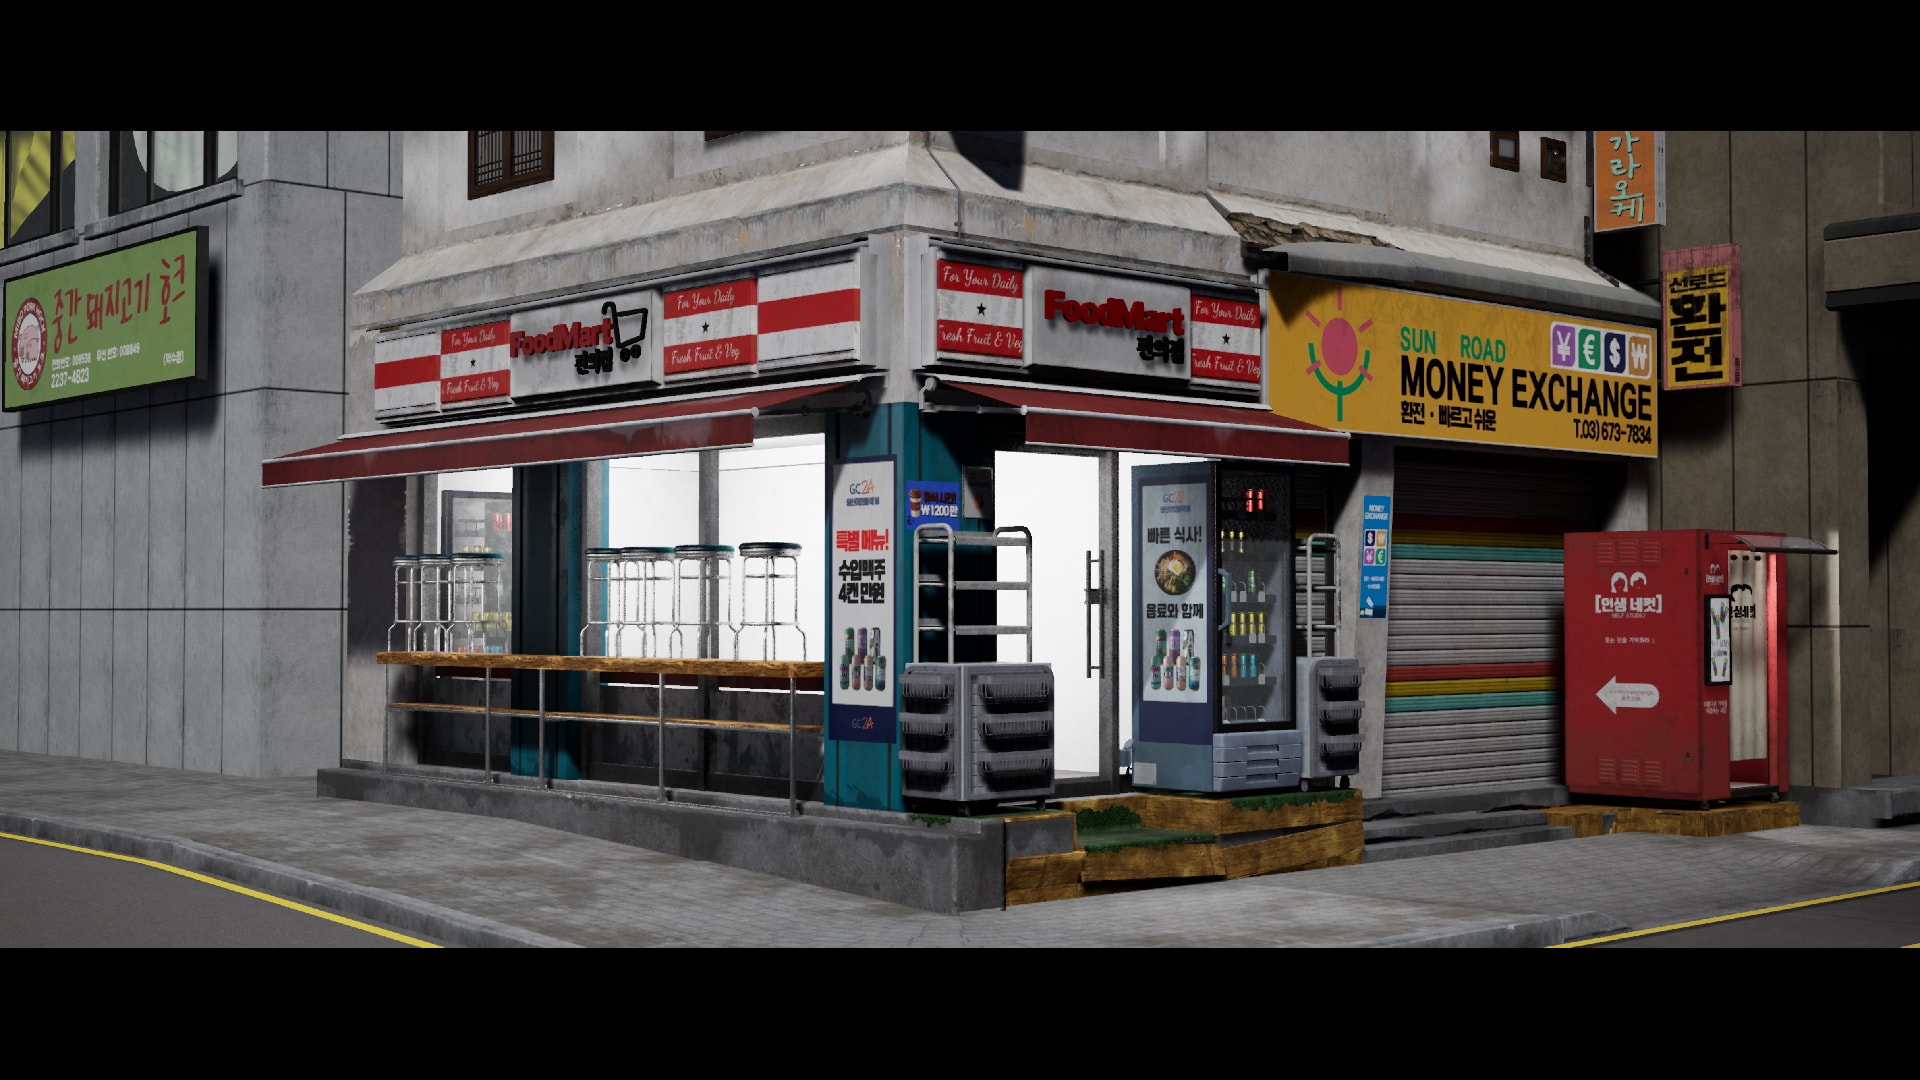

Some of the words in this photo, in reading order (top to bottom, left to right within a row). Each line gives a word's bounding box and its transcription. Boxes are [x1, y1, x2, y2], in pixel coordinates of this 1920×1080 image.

[1609, 131, 1644, 223] 가라오케
[943, 265, 960, 282] For
[963, 268, 990, 288] Your
[992, 273, 1018, 294] Daily
[1669, 272, 1726, 293] 선로드
[677, 295, 690, 311] For
[691, 293, 711, 310] Your
[713, 286, 735, 306] Daily
[52, 288, 82, 354] 중간
[87, 273, 150, 330] 돼지고기
[1044, 288, 1185, 337] FoodMart
[1195, 300, 1209, 315] For
[1211, 302, 1233, 319] Your
[1235, 305, 1257, 325] Daily
[451, 333, 461, 348] For
[462, 331, 478, 347] Your
[479, 327, 496, 344] Daily
[509, 317, 614, 358] FoodMart
[967, 328, 991, 345] Fruit
[994, 331, 1003, 347] &
[1399, 326, 1436, 355] SUN
[1460, 334, 1506, 363] ROAD
[1670, 292, 1726, 382] 환전
[671, 349, 692, 366] Fresh
[693, 347, 714, 363] Fruit
[715, 344, 723, 360] &
[724, 343, 741, 361] Veg
[1214, 355, 1234, 371] Fruit
[1236, 358, 1244, 374] &
[51, 367, 90, 389] 2237-4823
[446, 380, 463, 396] Fresh
[463, 379, 480, 393] Fruit
[480, 377, 486, 391] &
[487, 376, 499, 392] Veg
[1401, 355, 1504, 405] MONEY
[1512, 368, 1652, 421] EXCHANGE
[1401, 400, 1425, 425] 환전
[1438, 404, 1473, 429] 빠르고
[1474, 409, 1497, 432] 쉬운
[1601, 421, 1652, 444] 673-7834
[849, 479, 875, 495] GC24
[1162, 489, 1187, 503] GC24
[836, 530, 860, 552] 특별
[861, 528, 889, 551] 메뉴!
[1147, 526, 1171, 544] 빠른
[1173, 525, 1202, 543] 식사!
[838, 559, 886, 581] 수입맥주
[838, 582, 859, 604] 4캔
[860, 582, 885, 604] 만원
[1146, 603, 1178, 619] 음료와
[1181, 603, 1204, 619] 함께
[851, 716, 874, 730] GC24
